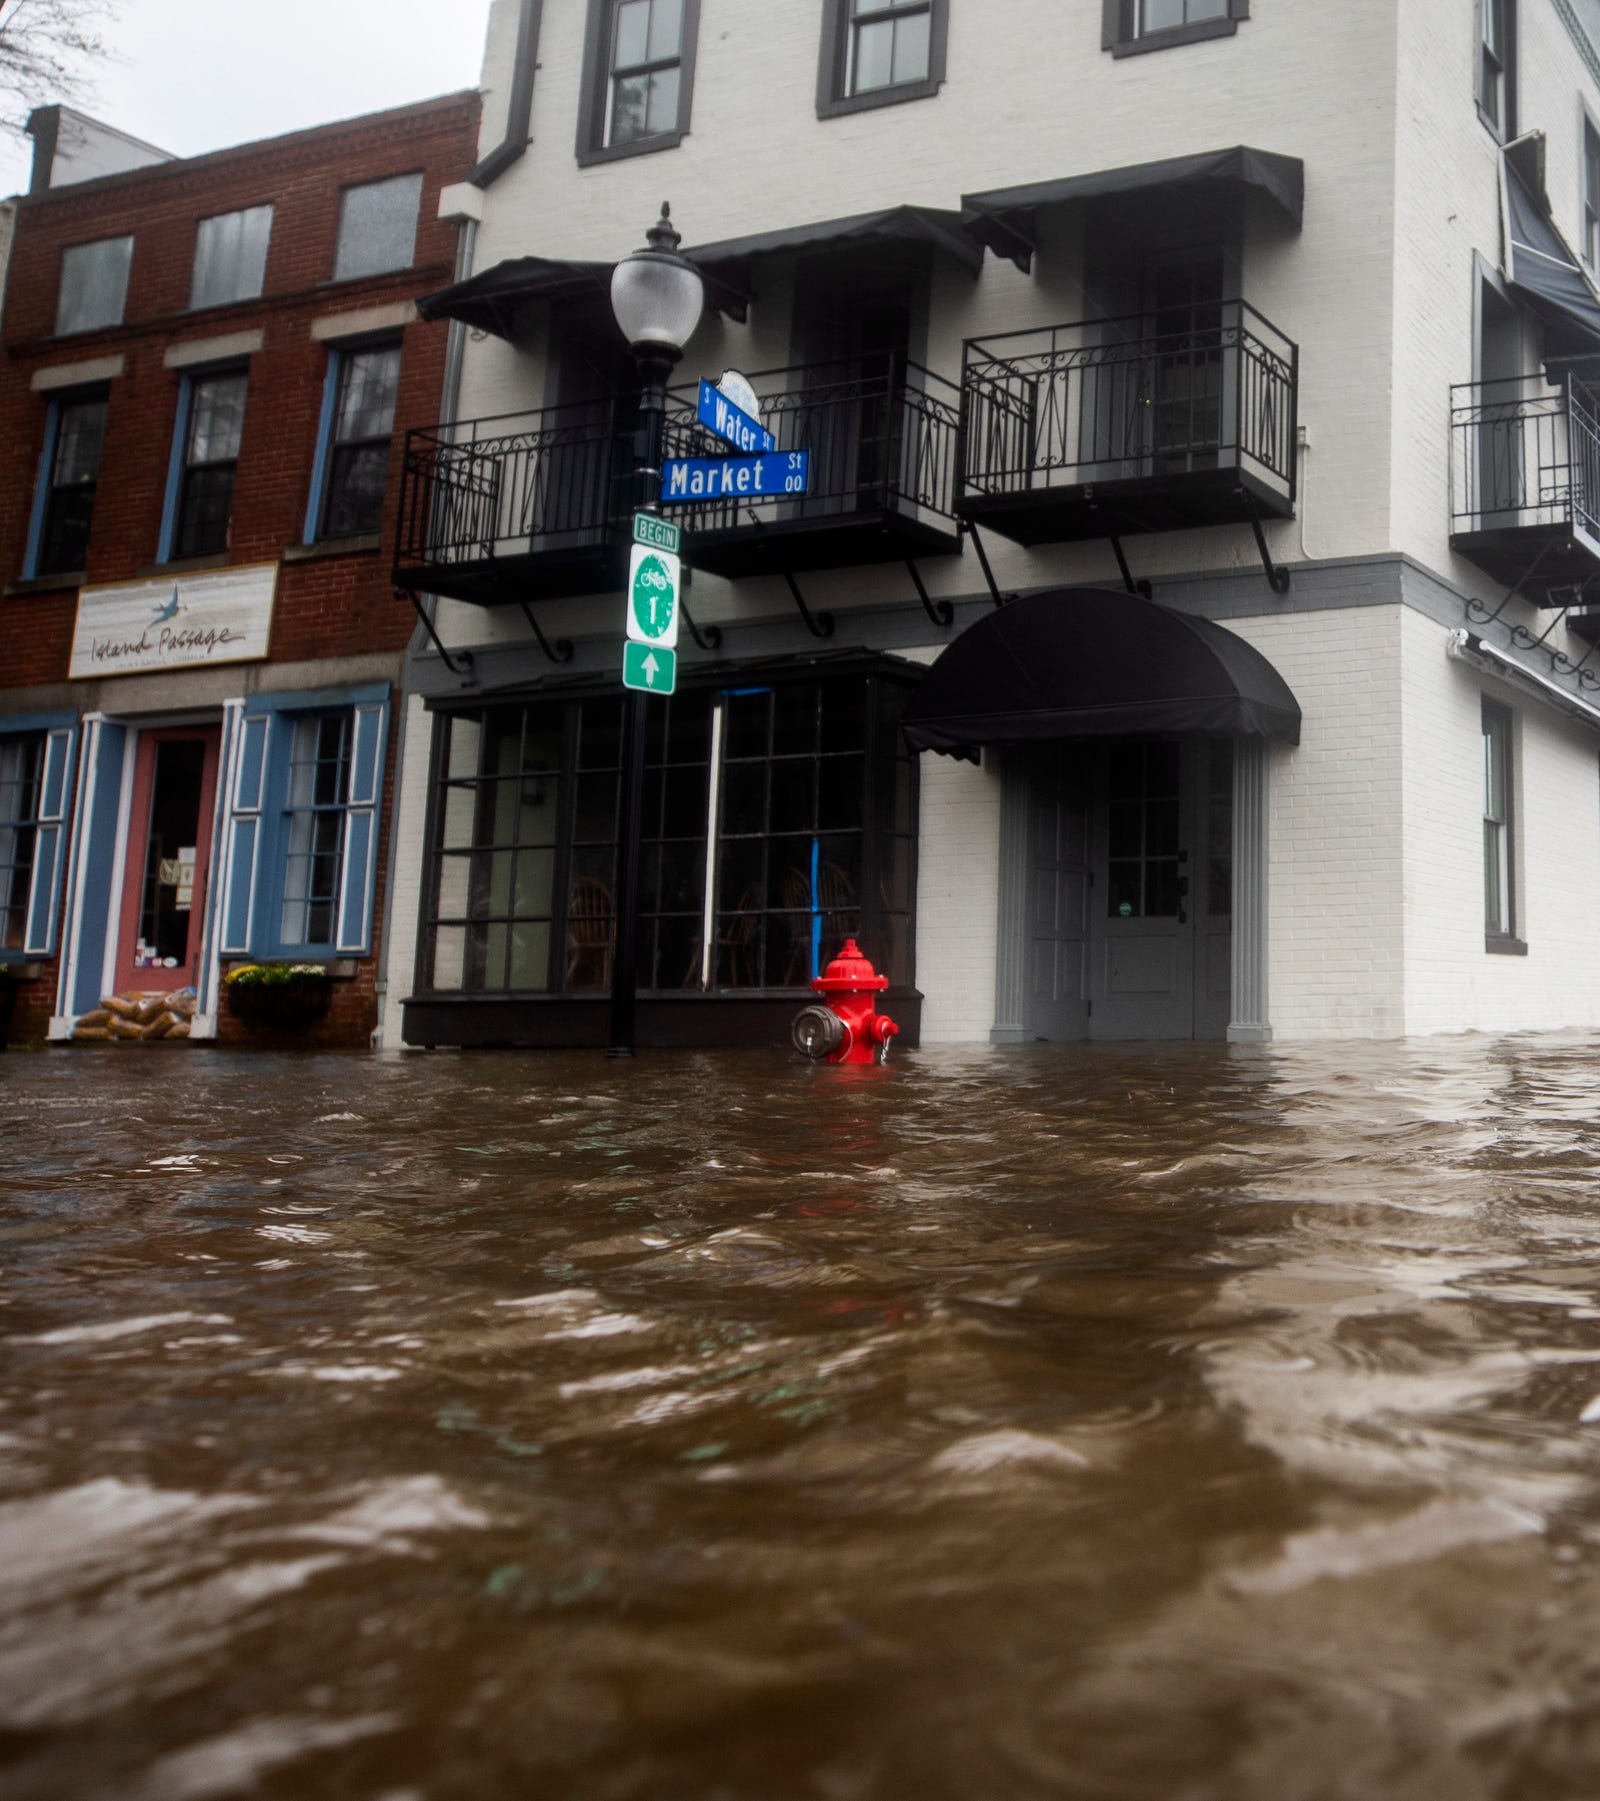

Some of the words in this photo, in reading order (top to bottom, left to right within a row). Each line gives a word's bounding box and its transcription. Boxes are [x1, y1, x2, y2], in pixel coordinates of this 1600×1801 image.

[704, 386, 710, 404] S
[715, 396, 757, 451] Water
[762, 431, 770, 450] St
[670, 459, 764, 496] Market
[788, 452, 802, 469] St
[784, 475, 802, 492] 00
[639, 519, 674, 547] BEGIN
[649, 596, 660, 624] 1
[91, 629, 152, 661] Island
[158, 627, 246, 654] Passage
